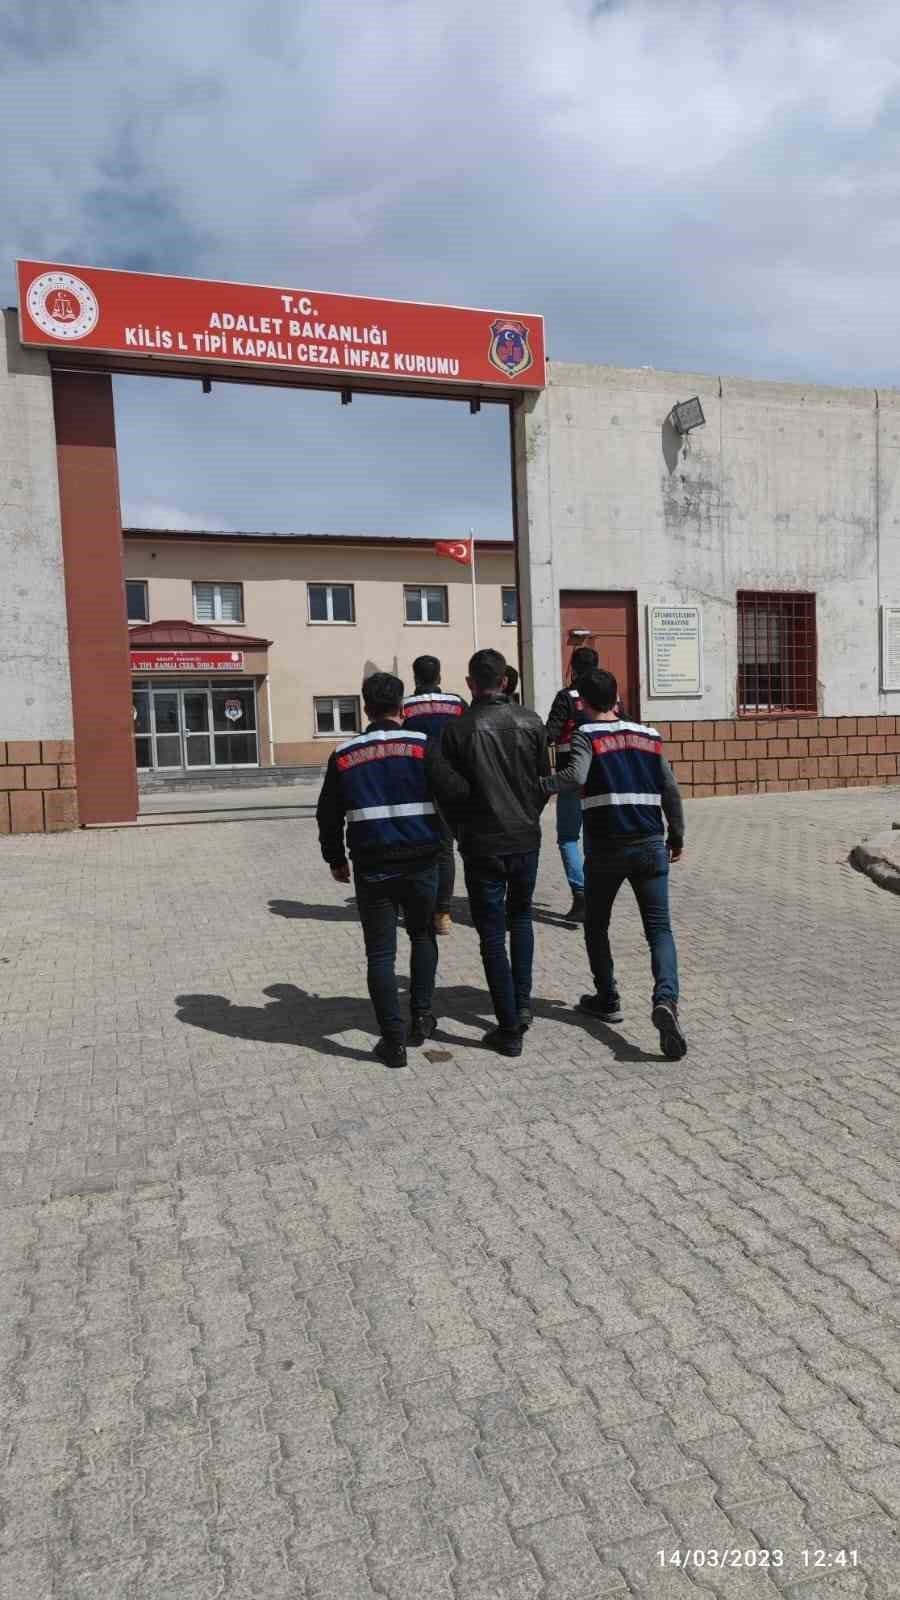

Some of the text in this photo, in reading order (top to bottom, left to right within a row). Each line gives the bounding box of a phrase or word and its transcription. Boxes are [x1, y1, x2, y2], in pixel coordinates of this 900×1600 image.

[281, 295, 319, 316] T.C.
[209, 312, 388, 345] ADALET BAKANLIĞI
[125, 324, 460, 376] KİLİS L TİPİ KAPALI CEZA İNFAZ KURUMU
